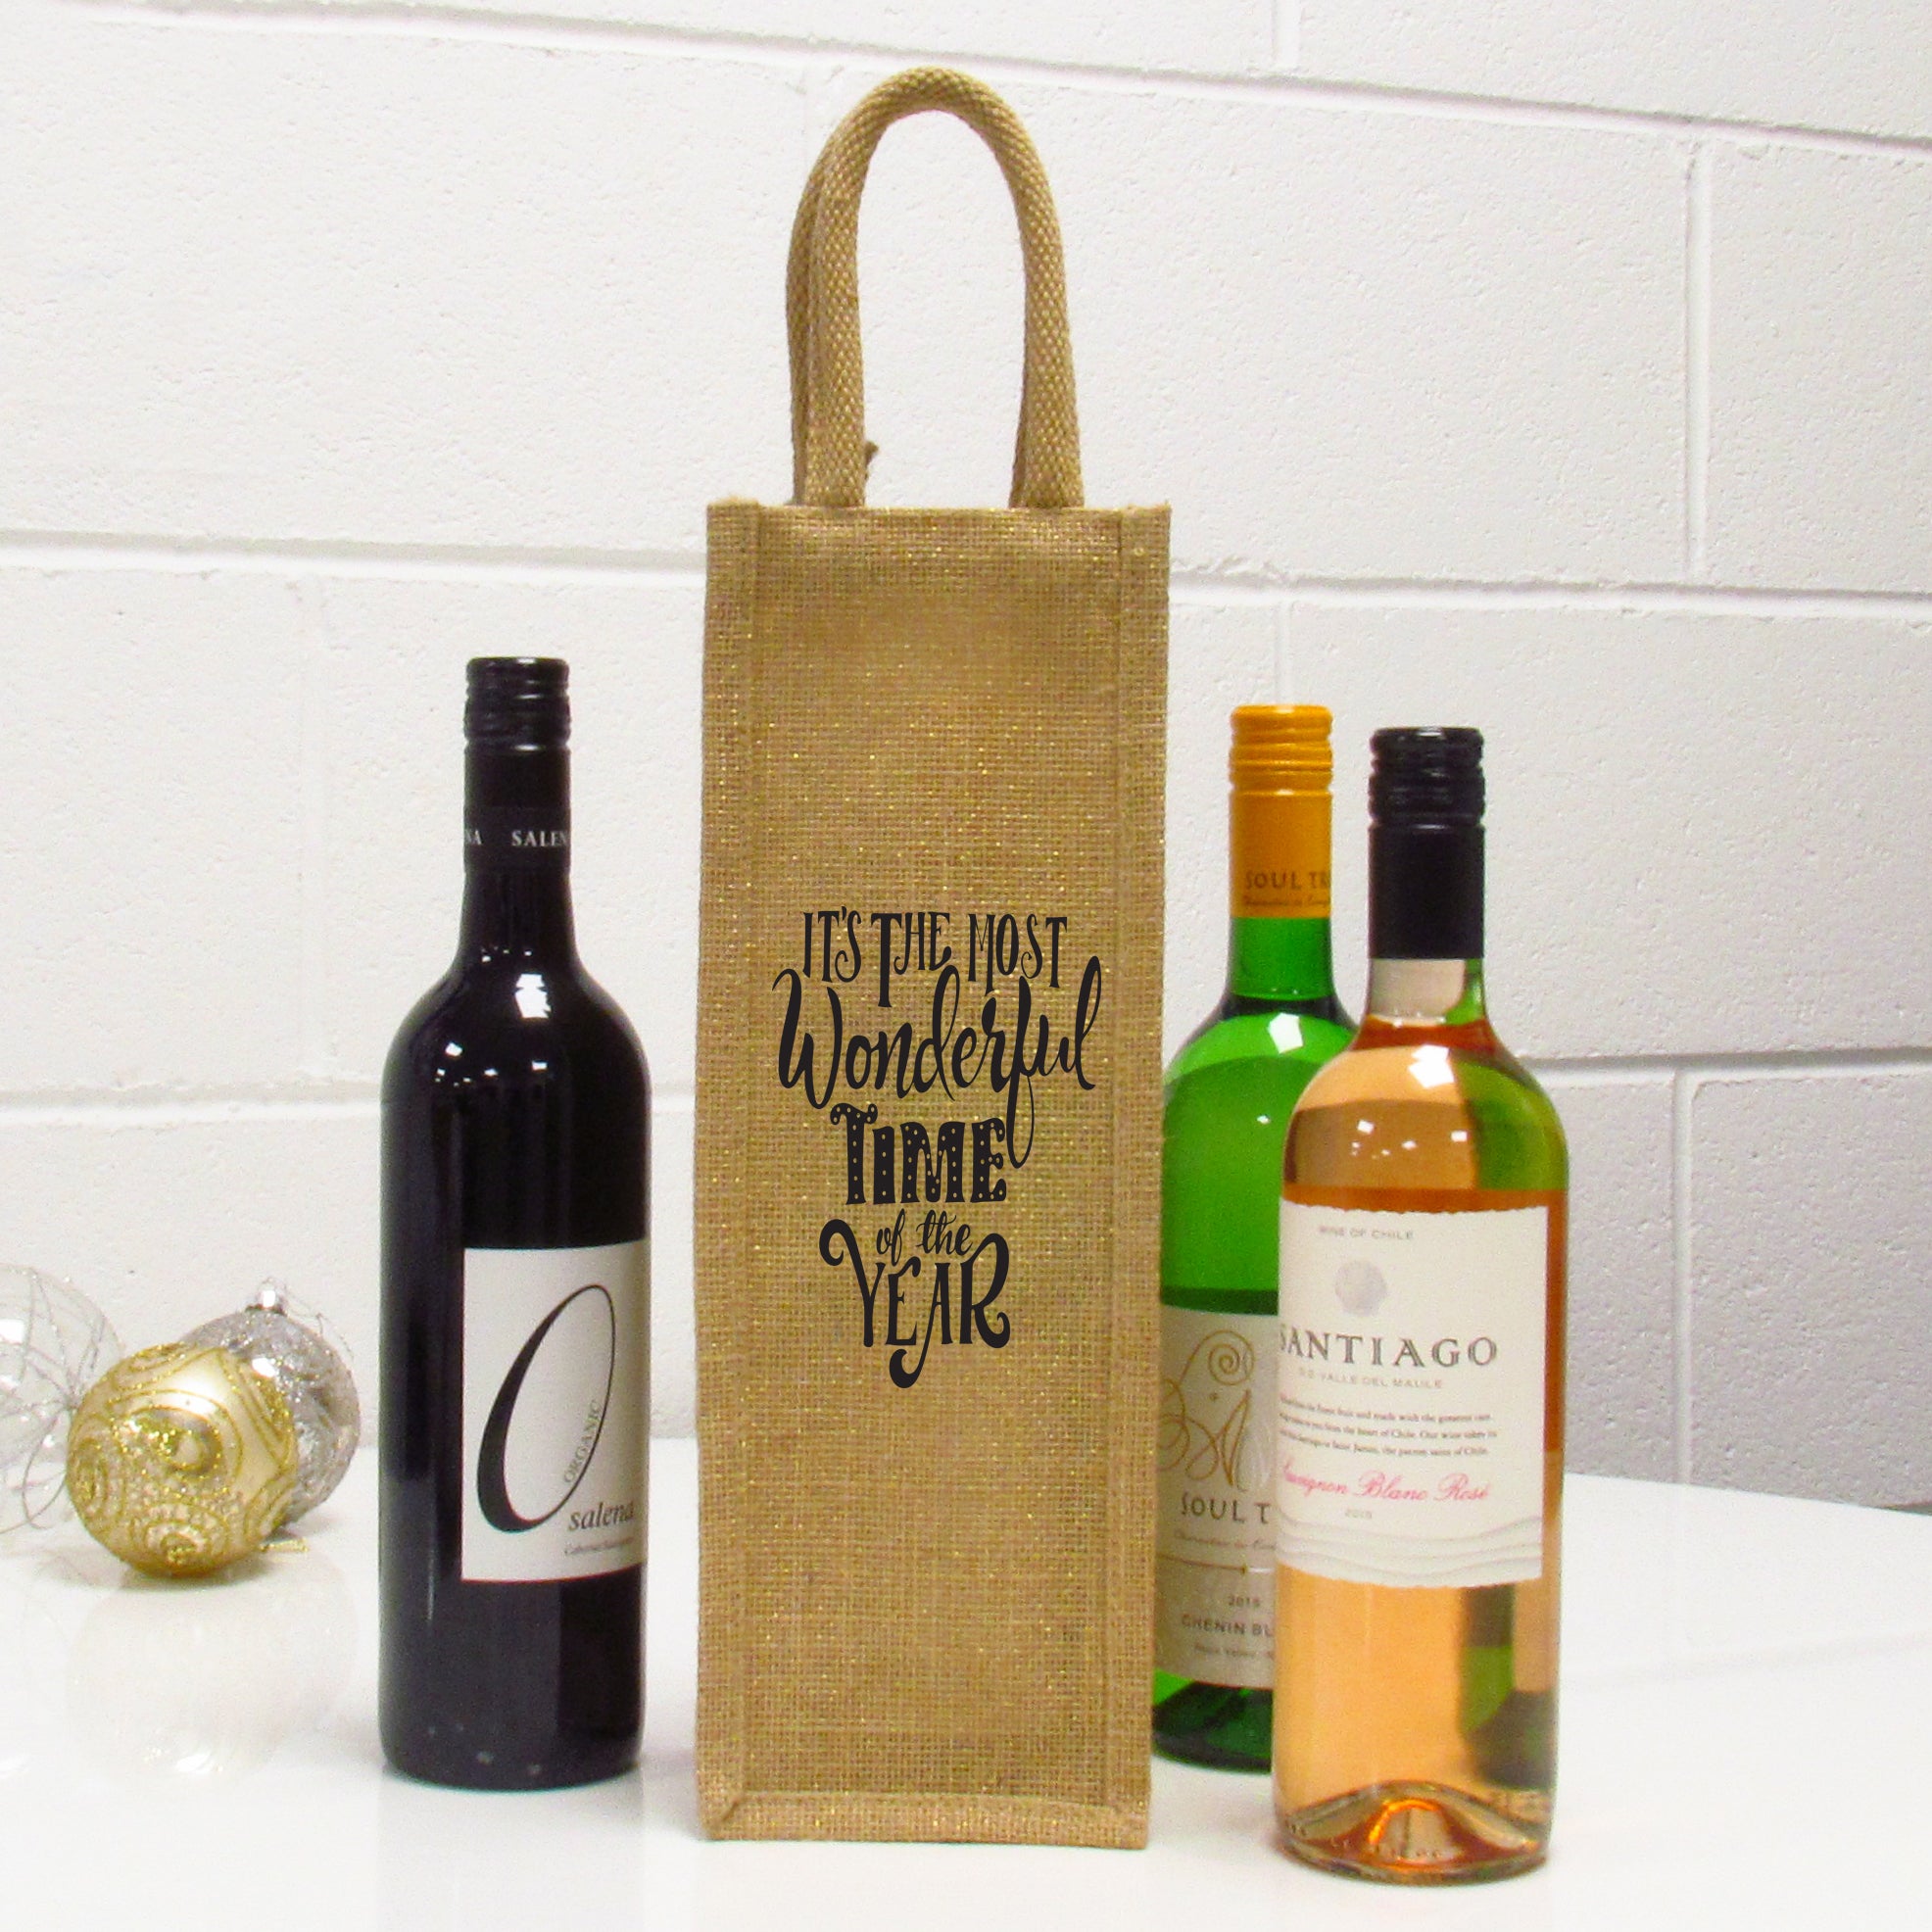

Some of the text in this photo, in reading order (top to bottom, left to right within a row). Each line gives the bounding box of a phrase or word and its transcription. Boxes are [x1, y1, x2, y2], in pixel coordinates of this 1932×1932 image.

[1245, 870, 1303, 891] SOUL
[802, 906, 1068, 1007] IT'S THE MOST
[772, 956, 1101, 1168] Wonderful
[830, 1102, 1007, 1205] TIME
[876, 1208, 973, 1266] of the
[819, 1219, 1011, 1388] YEAR
[563, 1399, 602, 1484] ORGANIC
[1182, 1492, 1246, 1523] SOUL
[1182, 1614, 1245, 1635] CHENIN
